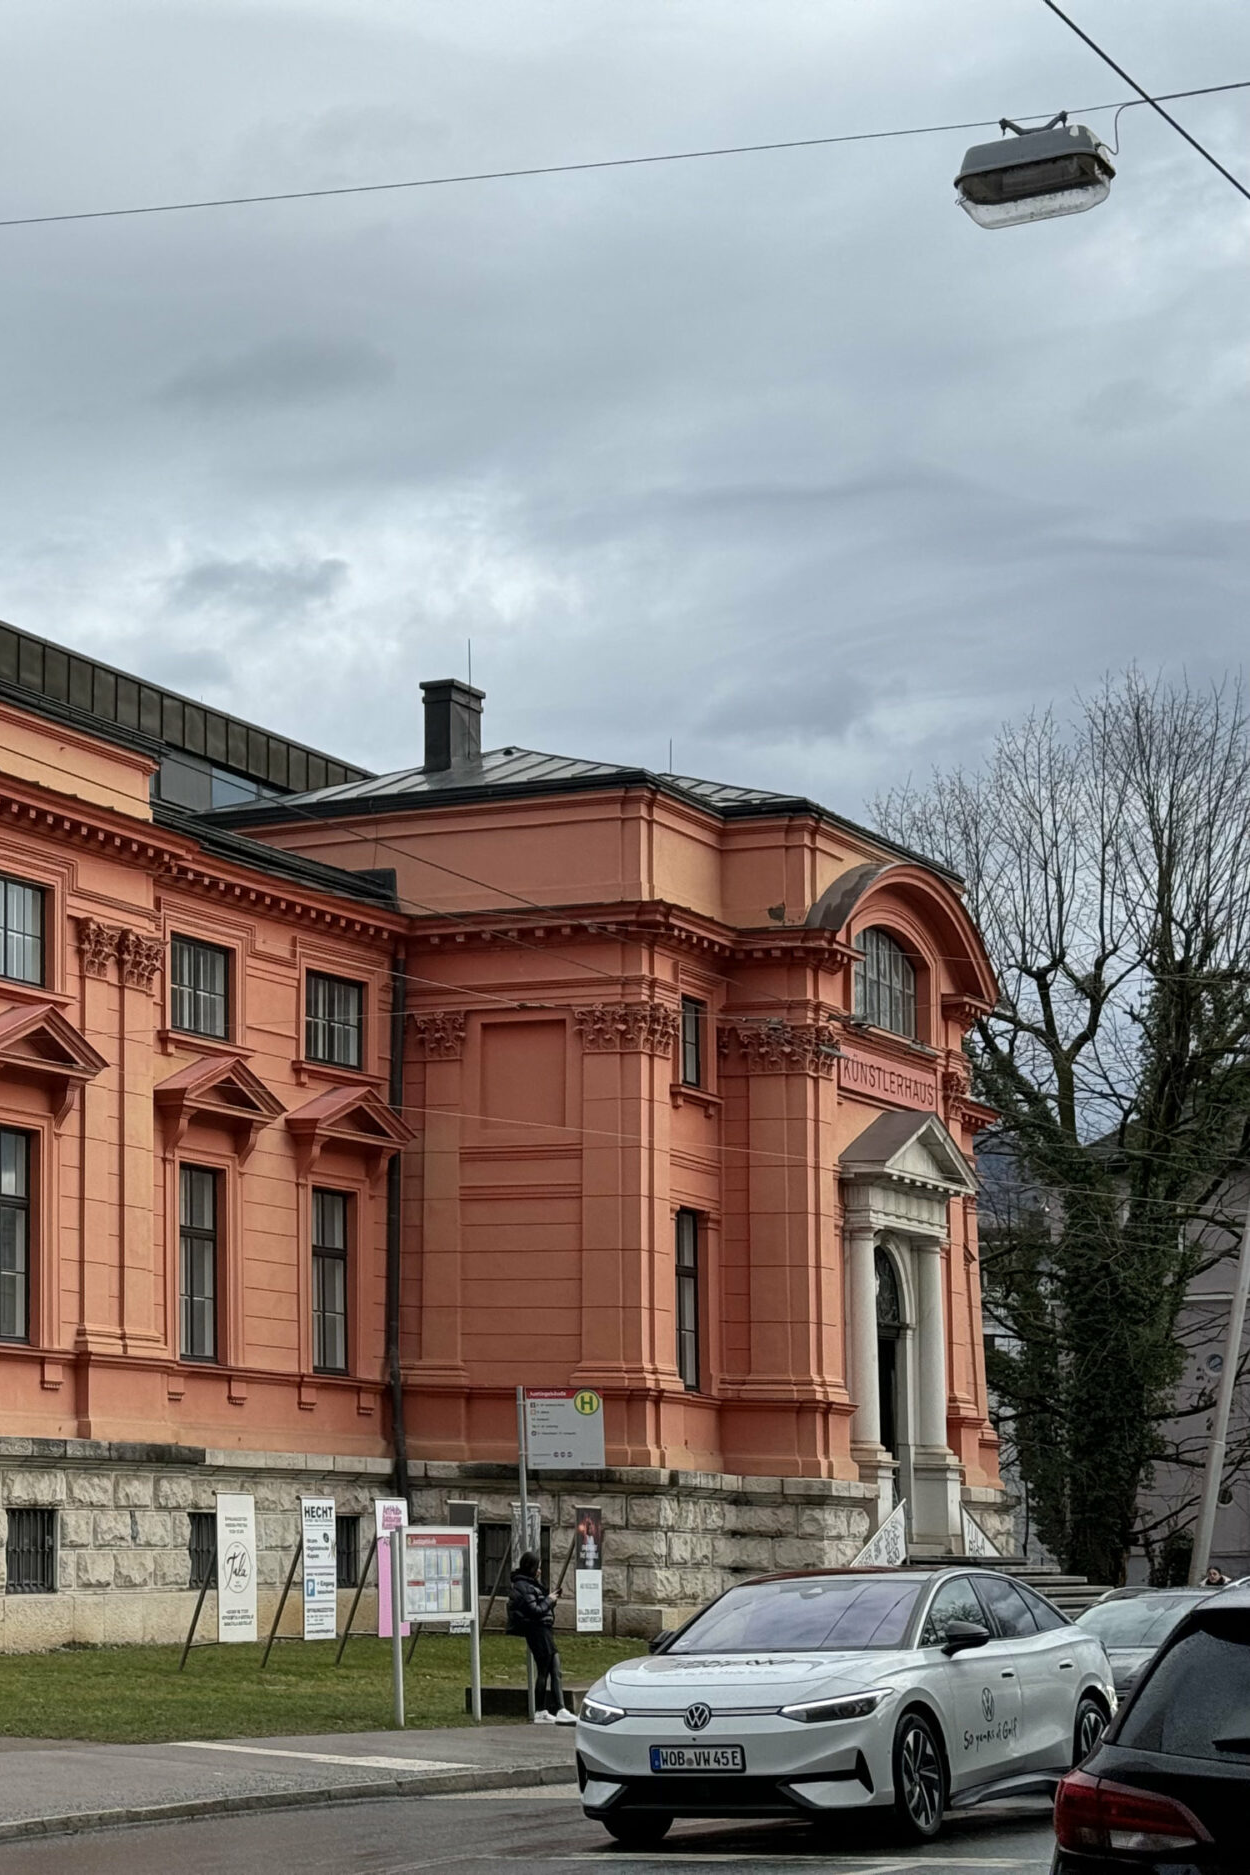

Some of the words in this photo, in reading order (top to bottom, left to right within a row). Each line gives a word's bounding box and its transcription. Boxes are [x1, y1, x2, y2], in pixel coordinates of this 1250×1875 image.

[843, 1053, 934, 1106] KÜNSTLERHAUS
[580, 1395, 594, 1411] H
[304, 1505, 333, 1518] HECHT
[963, 1730, 974, 1750] 50
[976, 1730, 995, 1752] years
[1002, 1716, 1018, 1740] Golf
[660, 1751, 686, 1766] WOB
[694, 1751, 711, 1766] VW
